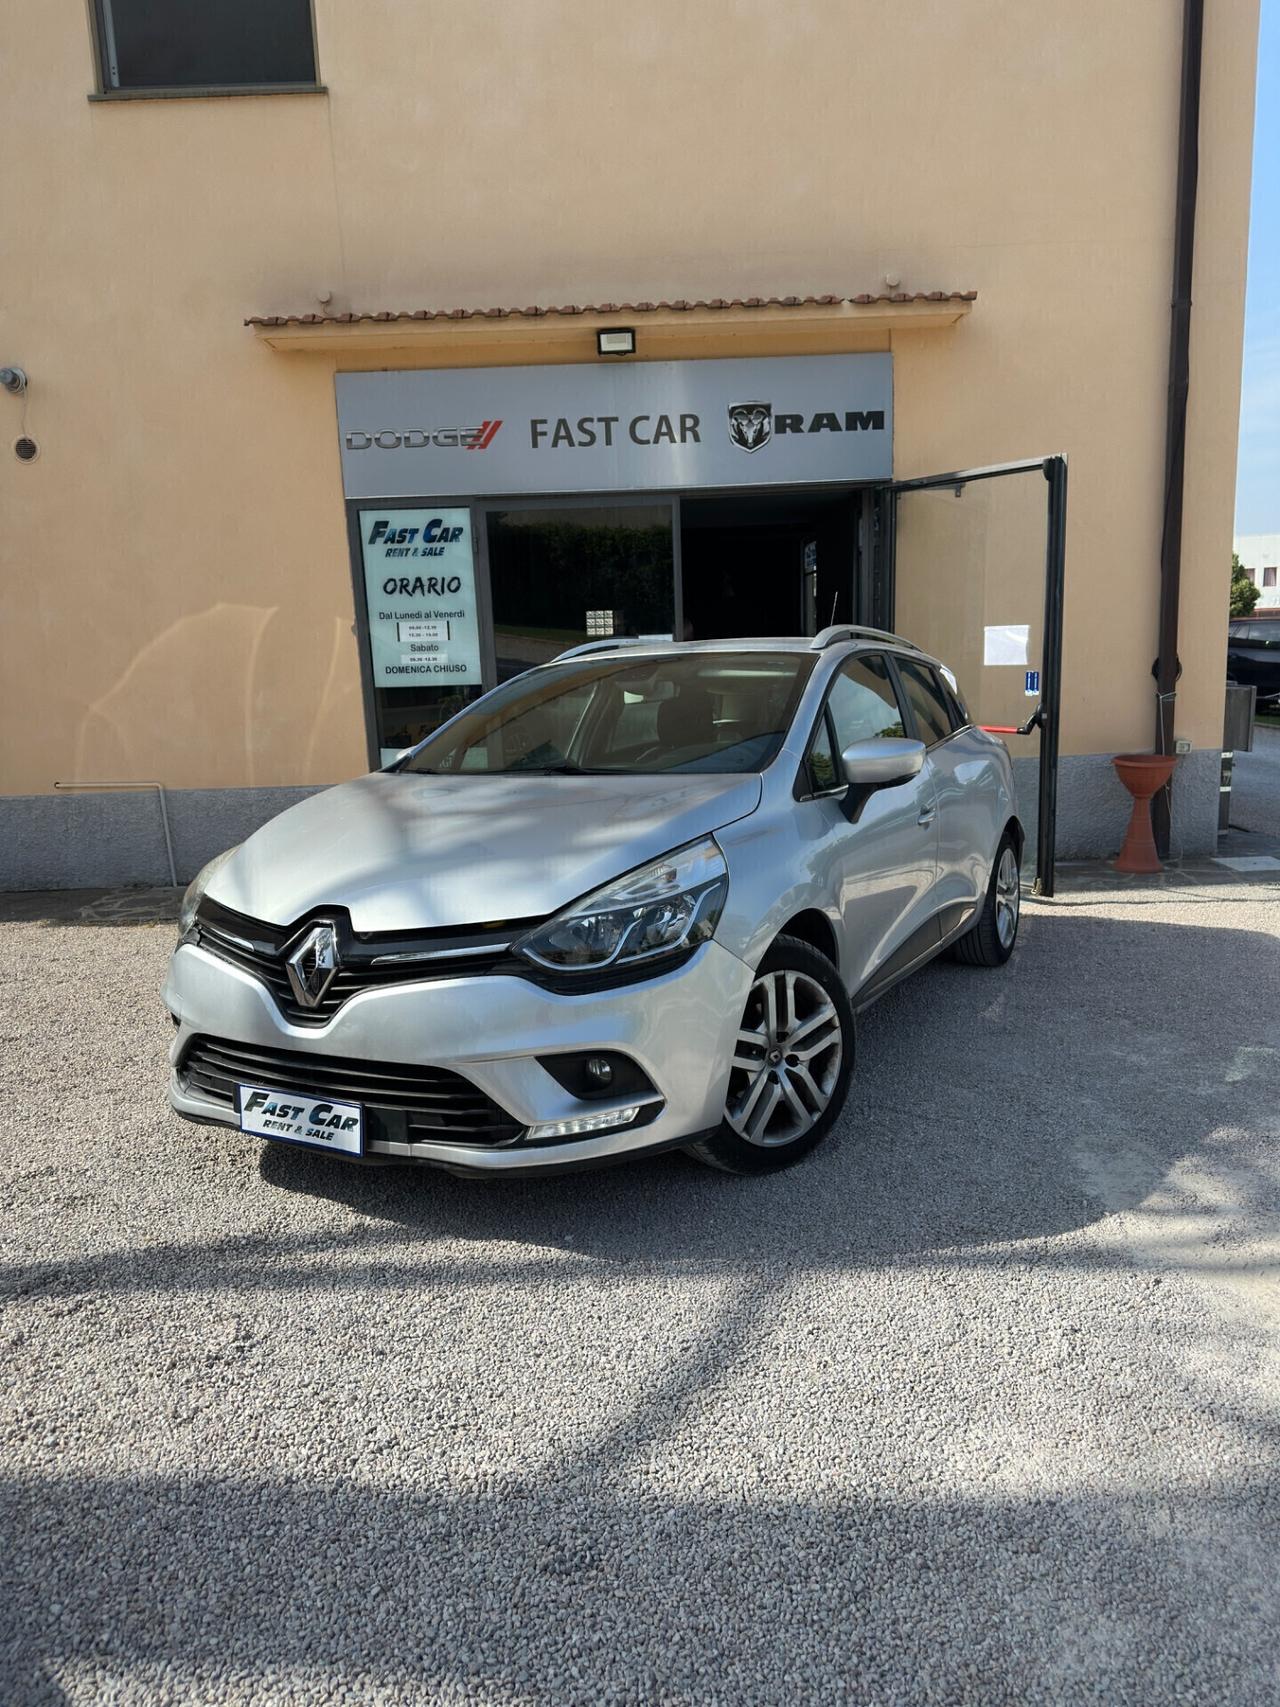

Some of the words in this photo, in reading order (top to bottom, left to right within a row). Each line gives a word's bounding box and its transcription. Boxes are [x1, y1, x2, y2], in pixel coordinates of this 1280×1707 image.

[530, 417, 619, 448] FAST
[629, 414, 701, 445] CAR
[774, 411, 885, 434] RAM
[346, 426, 484, 450] DODGE
[368, 520, 419, 545] FAST
[423, 519, 464, 544] CAR
[385, 548, 411, 557] RENT
[412, 548, 418, 557] &
[420, 547, 445, 557] SALE
[383, 576, 462, 597] ORARIO
[379, 612, 393, 620] Dal
[424, 611, 432, 619] al
[410, 643, 439, 652] Sabato
[385, 666, 432, 674] DOMENICA
[433, 664, 467, 673] CHIUSO
[244, 1091, 305, 1120] FAST
[309, 1103, 359, 1132] CAR
[263, 1119, 293, 1132] RENT
[294, 1126, 303, 1135] &
[305, 1128, 335, 1141] SALE
